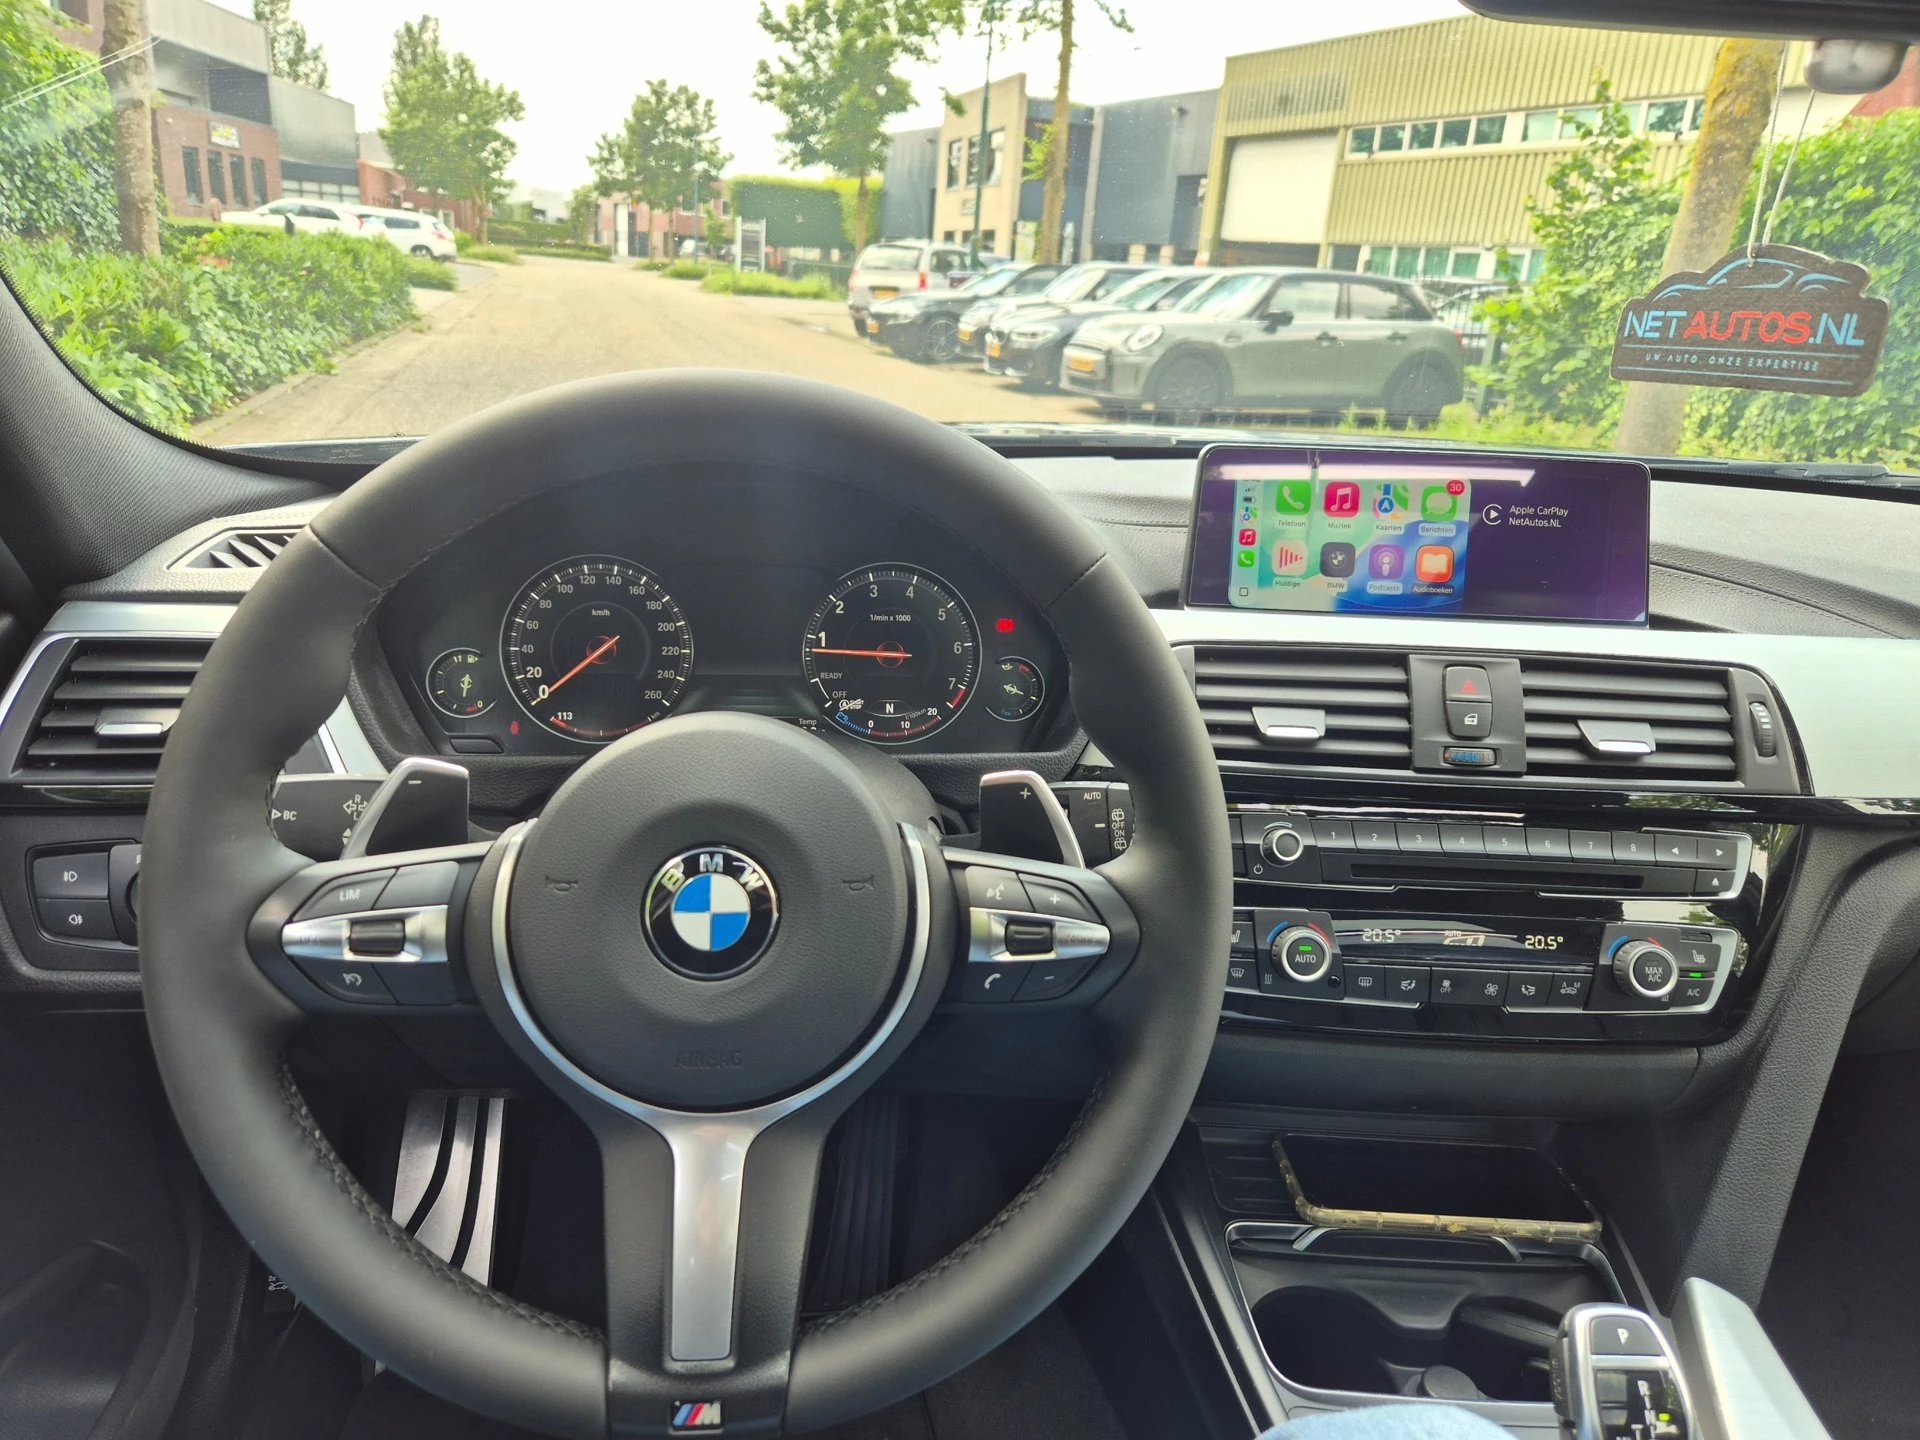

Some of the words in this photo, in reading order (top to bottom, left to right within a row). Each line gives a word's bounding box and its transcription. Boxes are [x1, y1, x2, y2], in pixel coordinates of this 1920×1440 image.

[1624, 310, 1865, 346] NETAUTOS.NL
[1645, 353, 1660, 361] UW
[1709, 356, 1741, 367] ONZE
[1748, 358, 1820, 371] EXPERTISE
[1449, 483, 1462, 492] 30
[1509, 505, 1535, 515] Apple
[1537, 506, 1569, 517] CarPlay
[1508, 517, 1561, 527] NetAutos.NL
[579, 575, 596, 585] 120
[605, 575, 622, 585] 140
[556, 584, 573, 594] 100
[628, 585, 645, 596] 160
[869, 585, 878, 597] 3
[905, 586, 914, 599] 4
[1412, 585, 1453, 594] Audioboeken
[540, 600, 552, 609] 80
[646, 601, 662, 611] 180
[835, 601, 844, 614] 2
[591, 608, 610, 617] km/h
[937, 609, 946, 620] 5
[870, 614, 888, 622] 1/min
[895, 614, 911, 622] 1000
[526, 621, 539, 630] 60
[657, 622, 675, 632] 200
[818, 631, 826, 647] 1
[521, 644, 534, 654] 40
[662, 646, 680, 656] 220
[953, 642, 962, 653] 6
[526, 667, 542, 678] 20
[657, 669, 675, 680] 240
[948, 678, 956, 690] 7
[538, 684, 549, 699] 0
[644, 690, 662, 700] 260
[832, 691, 848, 699] OFF
[886, 703, 894, 713] N
[927, 708, 937, 716] 20
[557, 711, 573, 720] 113
[799, 718, 817, 726] Temp
[868, 720, 874, 728] 0
[354, 795, 361, 803] R
[1083, 792, 1102, 800] AUTO
[283, 811, 297, 821] BC
[1112, 822, 1125, 830] OFF
[1331, 831, 1336, 840] 1
[1372, 833, 1377, 842] 2
[1415, 835, 1421, 843] 3
[1459, 837, 1465, 845] 4
[1502, 838, 1507, 847] 5
[1545, 840, 1550, 849] 6
[1588, 842, 1593, 850] 7
[1631, 844, 1636, 852] 8
[660, 853, 764, 893] BMW
[340, 889, 360, 901] LIM
[1524, 935, 1563, 950] 20.5°
[1295, 954, 1316, 964] AUTO
[1645, 967, 1663, 975] MAX
[1648, 974, 1662, 983] A/C
[1687, 988, 1700, 997] A/C
[1617, 1328, 1629, 1344] P
[1638, 1380, 1651, 1396] R
